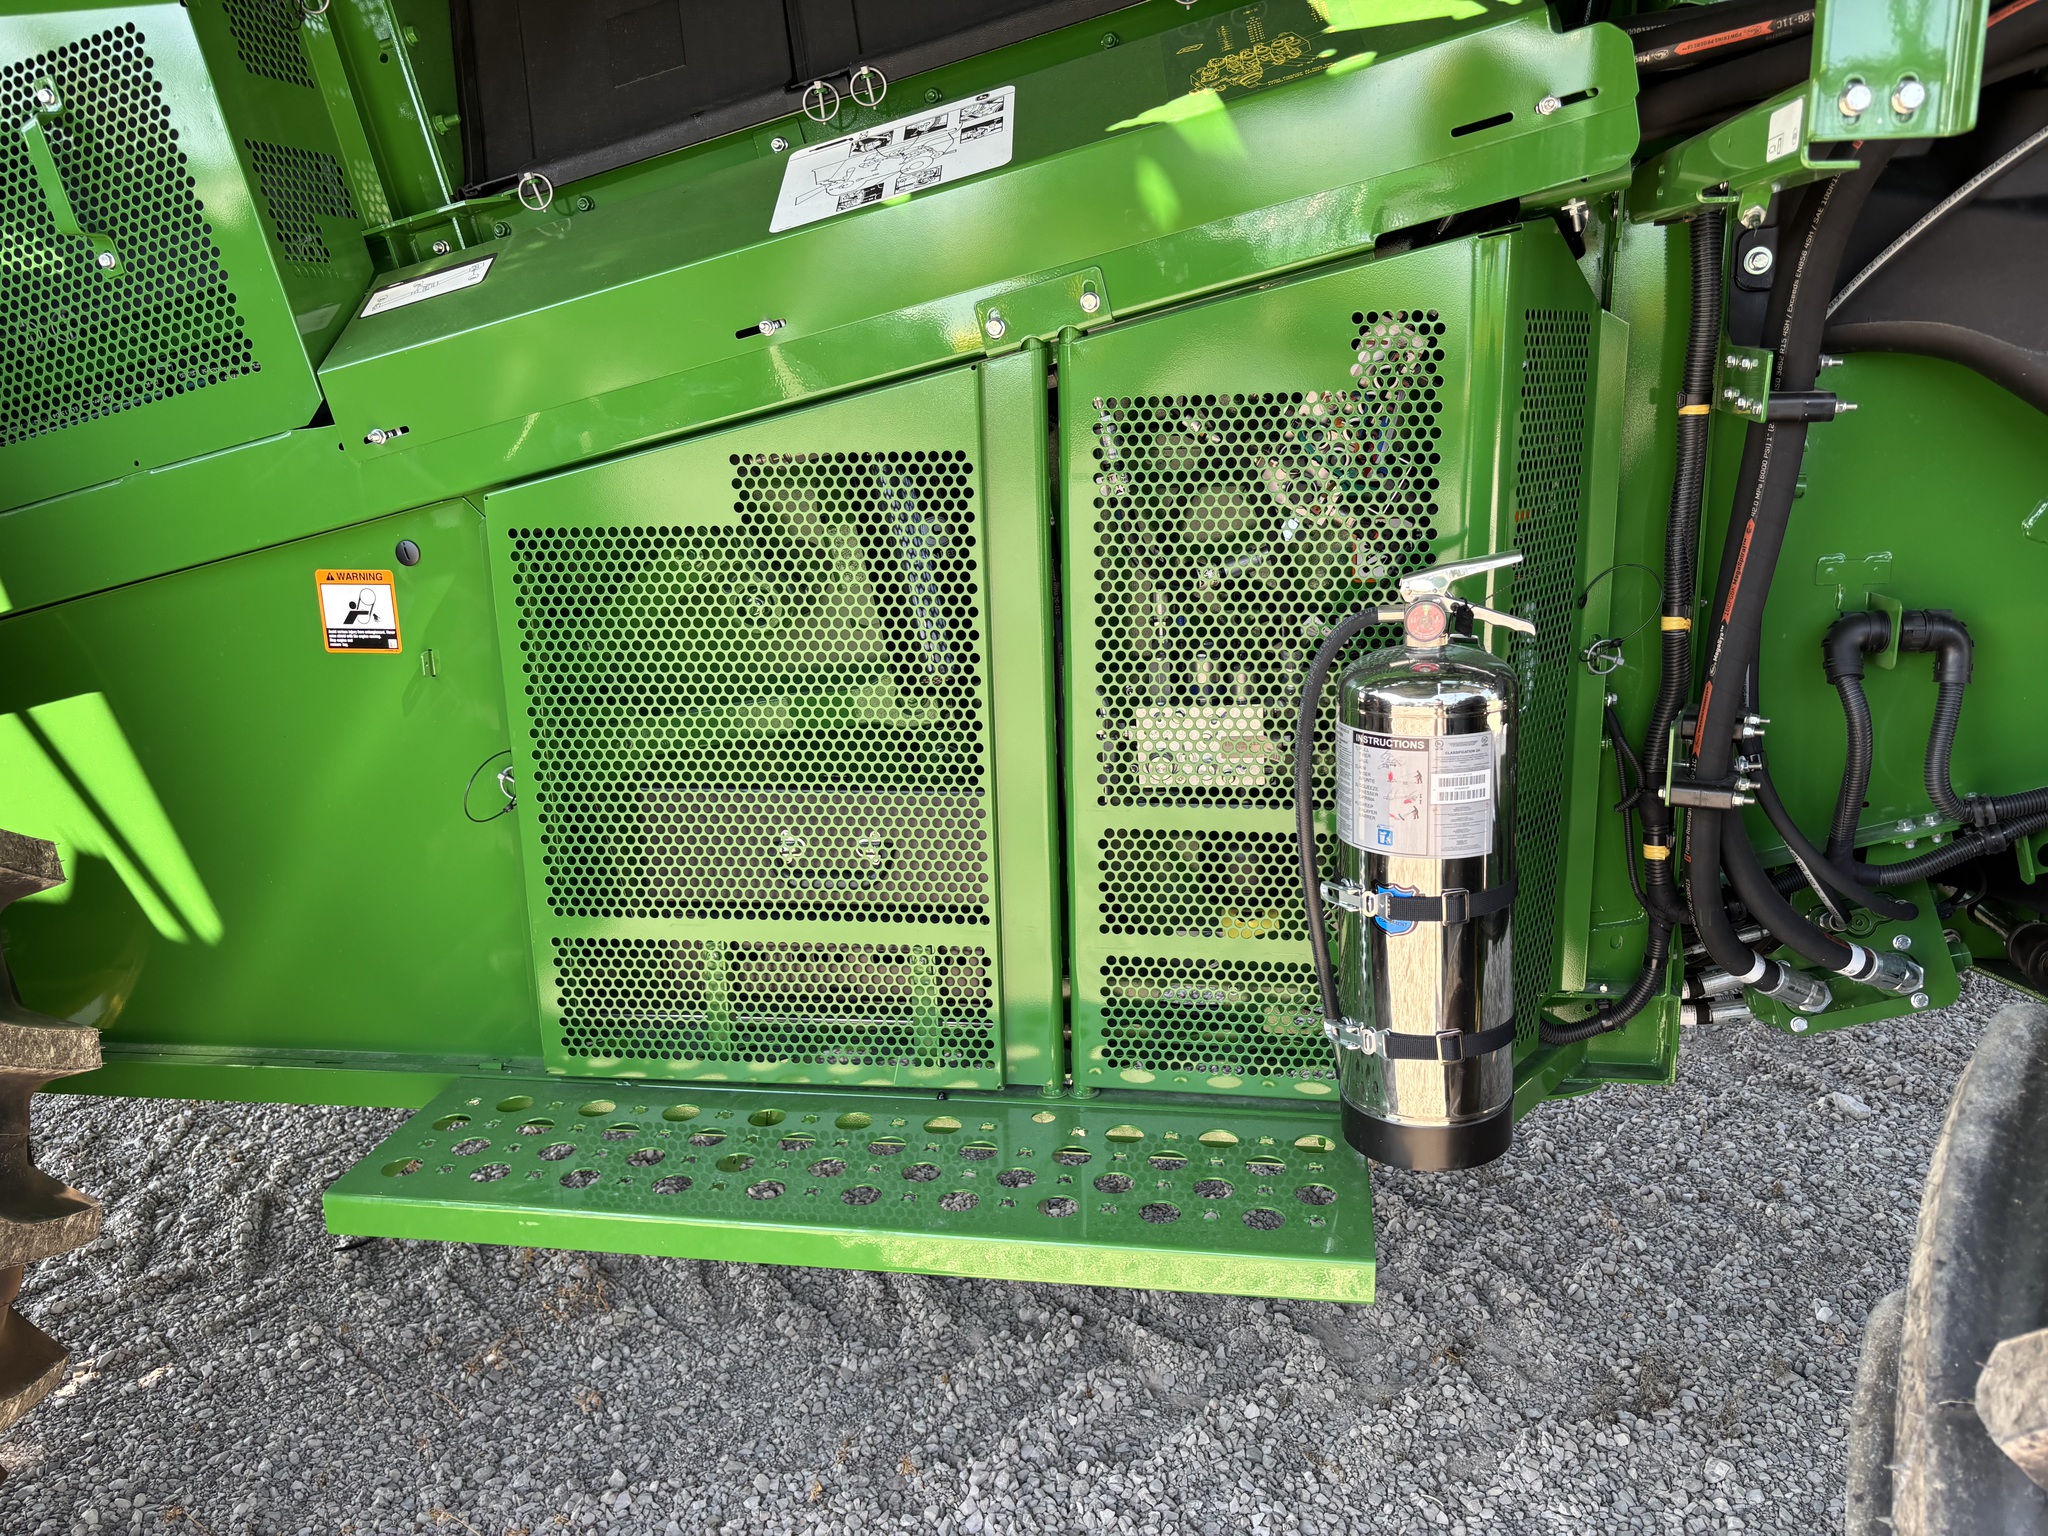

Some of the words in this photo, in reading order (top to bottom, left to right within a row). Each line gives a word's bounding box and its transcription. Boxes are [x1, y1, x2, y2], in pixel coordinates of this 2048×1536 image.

[1776, 12, 1810, 29] 2G-11C
[1813, 206, 1825, 224] SAE
[1828, 293, 1842, 310] MAX
[1839, 285, 1851, 299] WP
[1850, 275, 1862, 289] 215
[1861, 261, 1876, 277] BAR
[1892, 236, 1904, 250] PSI
[1905, 218, 1925, 238] MSHA
[1953, 182, 1973, 199] FRAS
[1980, 148, 2018, 179] ABRASION
[1805, 230, 1815, 249] 4SH
[1787, 279, 1800, 313] Exceeds
[1782, 320, 1791, 337] 4SH
[1779, 337, 1788, 354] R15
[1776, 355, 1785, 376] 3862
[1774, 377, 1782, 391] ISO
[1754, 482, 1763, 500] MPa
[1750, 498, 1760, 517] 42.0
[336, 572, 383, 581] WARNING
[1355, 733, 1425, 749] INSTRUCTIONS
